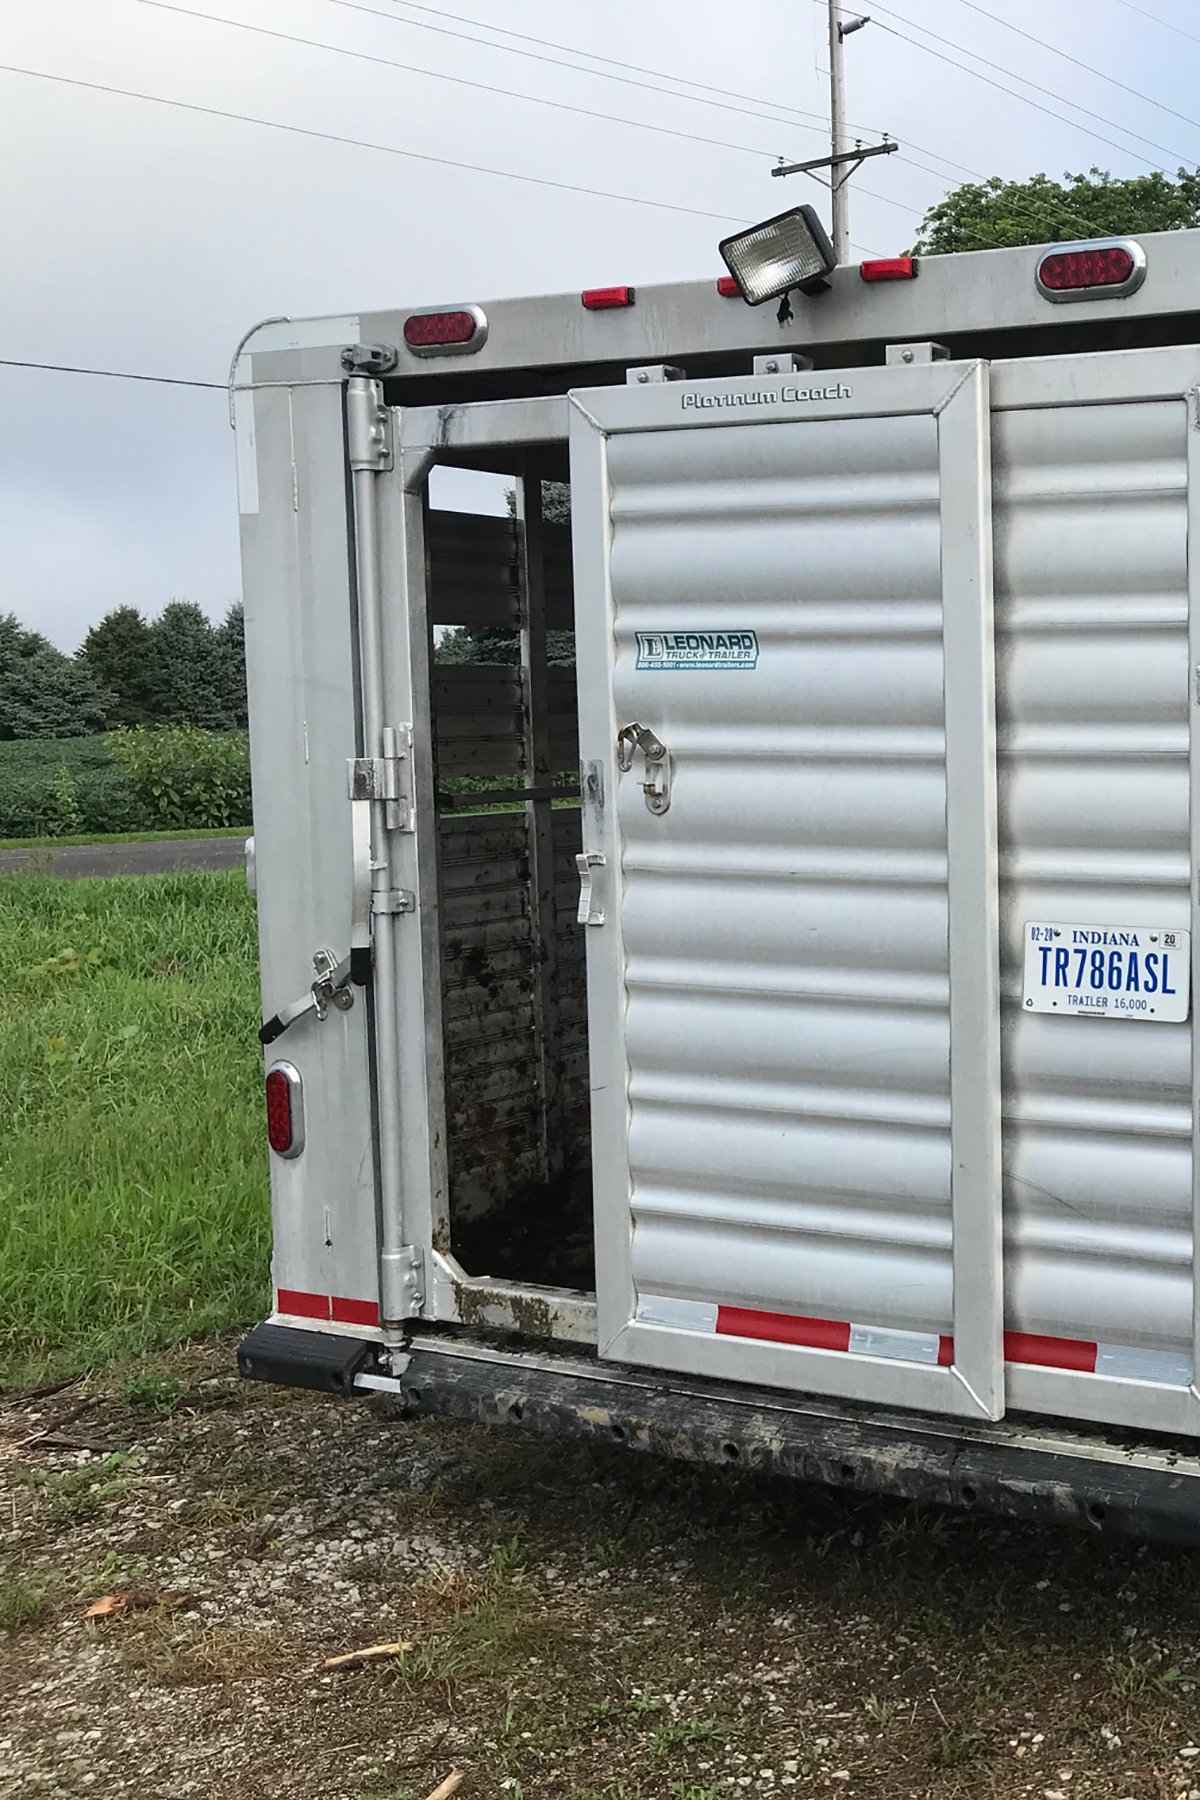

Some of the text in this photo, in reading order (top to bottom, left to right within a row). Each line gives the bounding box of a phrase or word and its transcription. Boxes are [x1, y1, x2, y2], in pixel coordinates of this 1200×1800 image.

[682, 384, 852, 409] Platinum Coach
[663, 635, 753, 650] LEONARD
[666, 651, 699, 660] TRUCK
[709, 651, 751, 659] TRAILER
[1072, 930, 1140, 947] INDIANA
[1164, 933, 1176, 944] 20
[1038, 946, 1176, 994] TR786ASL
[1067, 994, 1147, 1011] TRAILER 16,000
